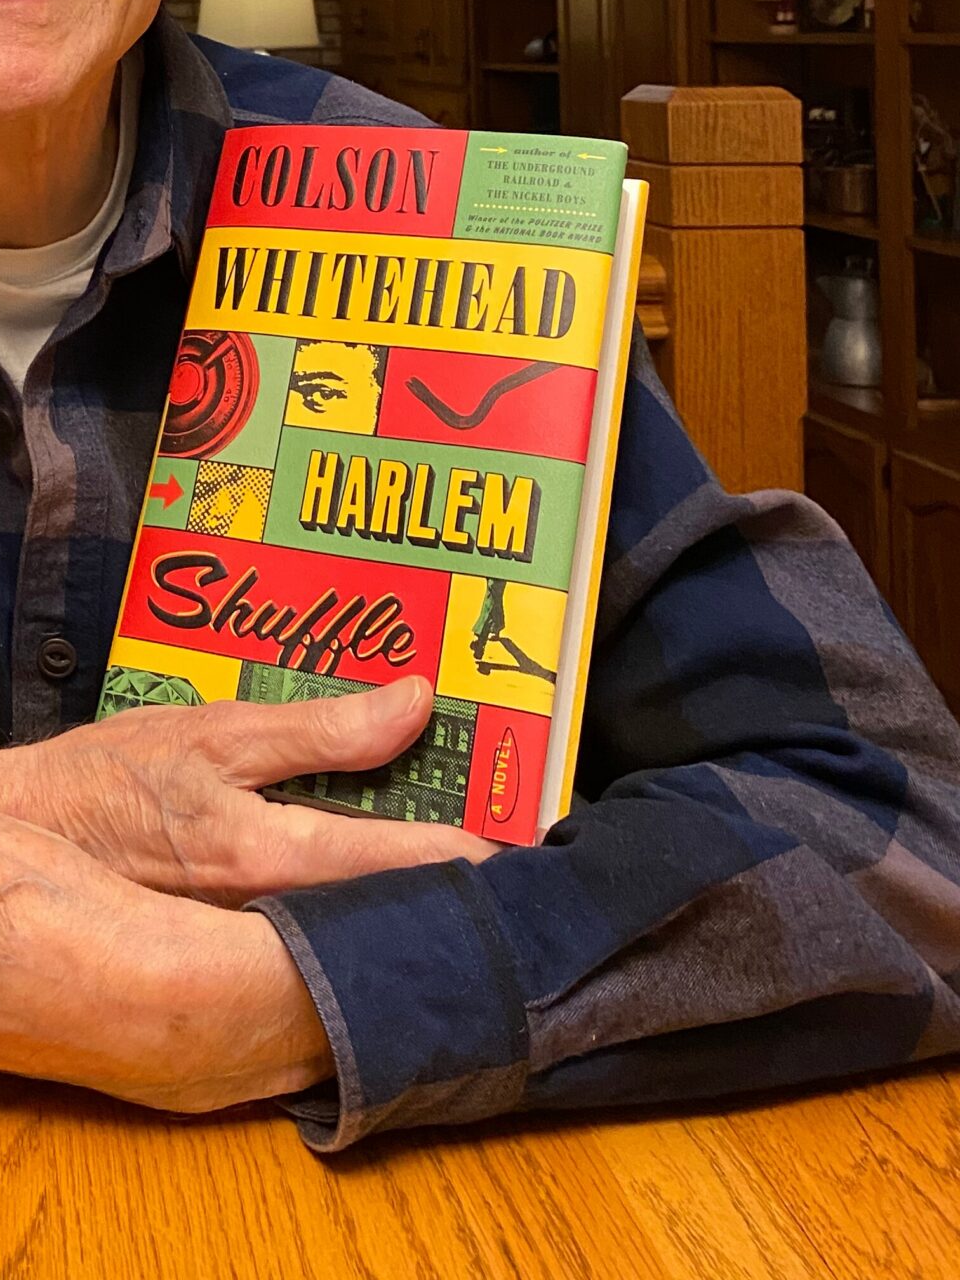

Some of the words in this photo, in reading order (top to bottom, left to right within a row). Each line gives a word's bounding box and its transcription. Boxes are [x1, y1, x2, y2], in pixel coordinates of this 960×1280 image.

[514, 148, 556, 156] author
[559, 150, 572, 159] of
[487, 160, 509, 170] THE
[512, 161, 595, 177] UNDERGROUND
[232, 145, 440, 215] COLSON
[503, 175, 560, 187] RAILROAD
[487, 189, 509, 199] THE
[512, 190, 552, 202] NICKEL
[556, 194, 586, 205] BOYS
[468, 214, 497, 223] Winner
[511, 217, 525, 225] the
[527, 218, 573, 229] PULITZER
[575, 222, 603, 232] PRIZE
[475, 225, 490, 233] the
[493, 227, 536, 236] NATIONAL
[539, 229, 565, 239] BOOK
[568, 233, 602, 243] AWARD
[214, 246, 577, 339] WHITEHEAD
[299, 449, 542, 563] HARLEM
[147, 550, 417, 675] Shuffle
[492, 738, 512, 795] NOVEL
[491, 804, 502, 815] A
